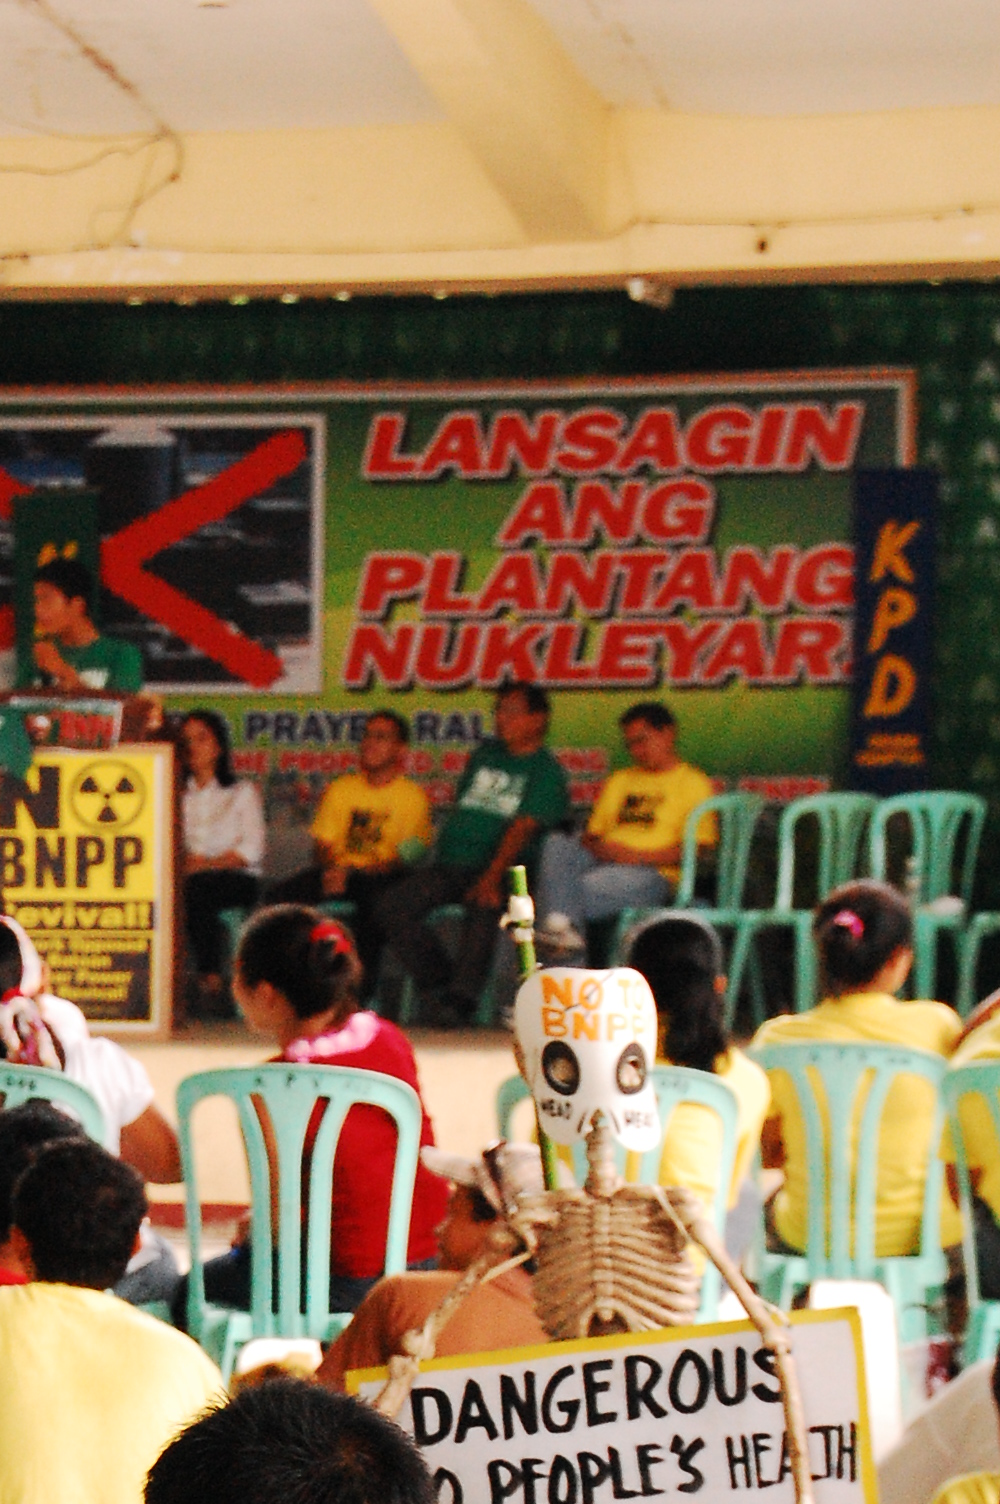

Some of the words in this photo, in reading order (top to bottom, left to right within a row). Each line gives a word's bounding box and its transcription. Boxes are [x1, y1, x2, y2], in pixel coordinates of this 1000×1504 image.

[362, 402, 866, 479] LANSAGIN
[497, 475, 716, 546] ANG
[356, 542, 855, 619] PLANTANG
[243, 710, 370, 744] PRAYE
[412, 710, 484, 744] RAL
[3, 900, 151, 930] evival!
[540, 974, 604, 1010] NO
[409, 1346, 785, 1447] DANGEROUS
